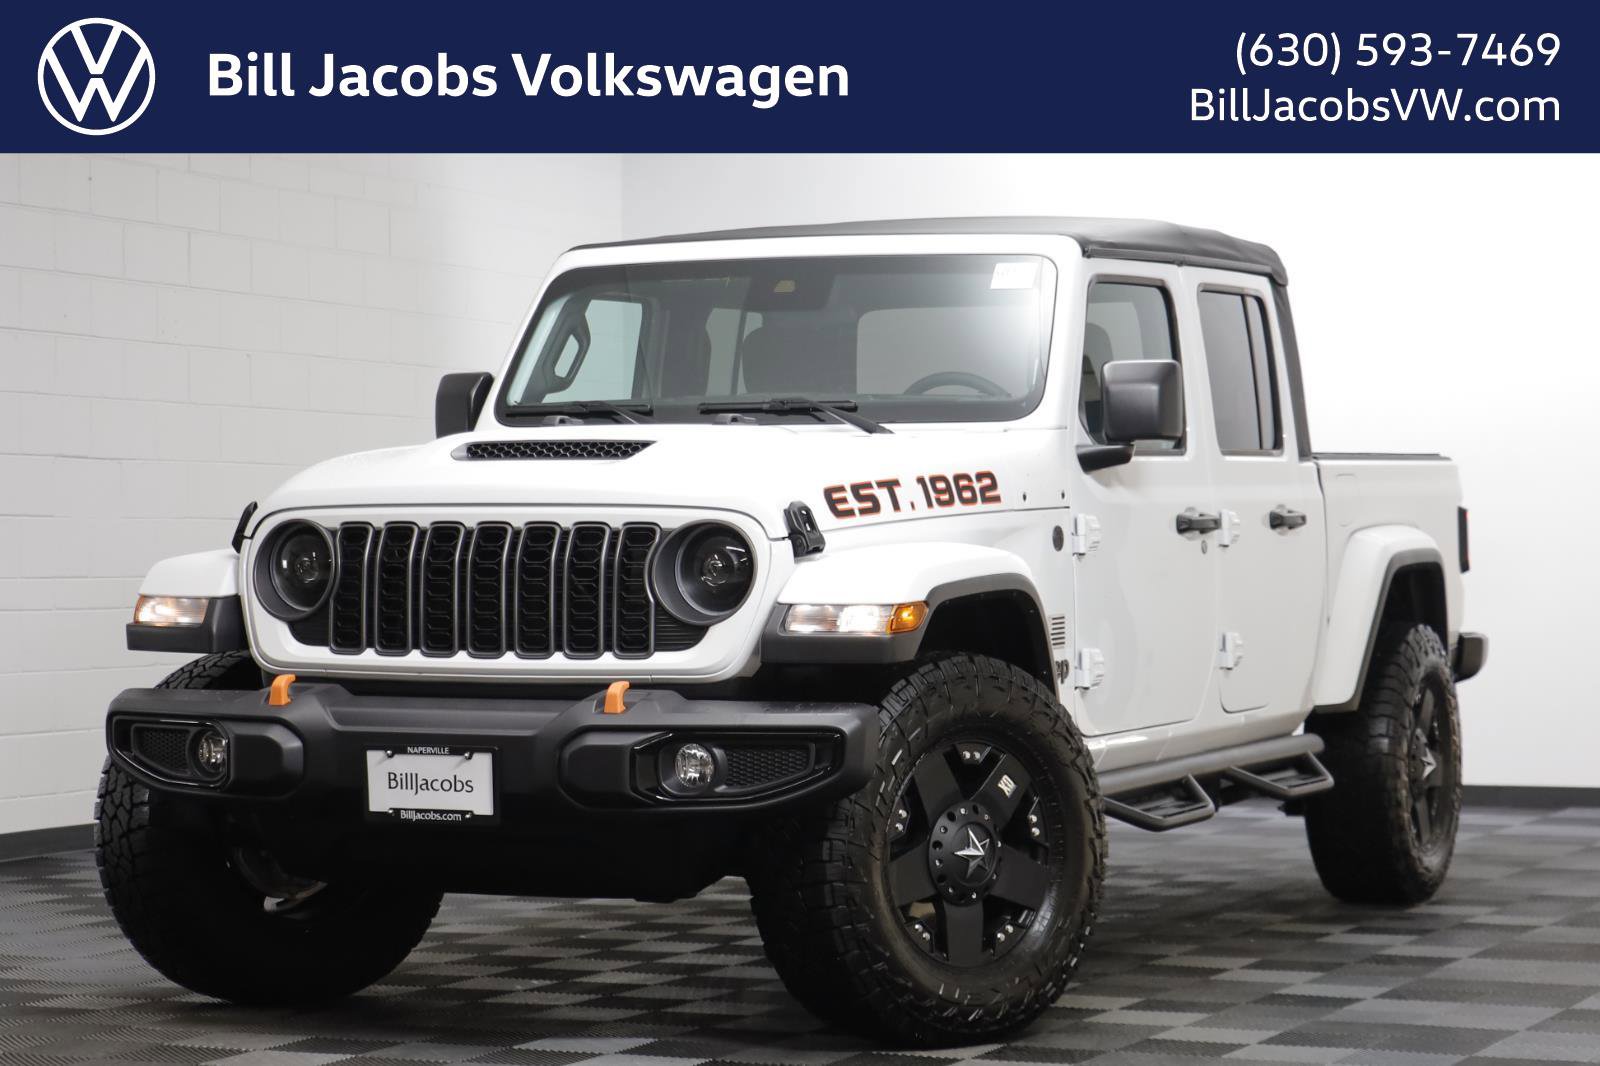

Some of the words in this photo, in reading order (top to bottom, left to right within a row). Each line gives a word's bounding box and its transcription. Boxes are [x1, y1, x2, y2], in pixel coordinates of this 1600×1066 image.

[916, 470, 1002, 509] 1962
[407, 746, 450, 755] NAPERVILLE
[387, 771, 474, 796] BillJacobs
[400, 809, 462, 822] BillJacobs.com
